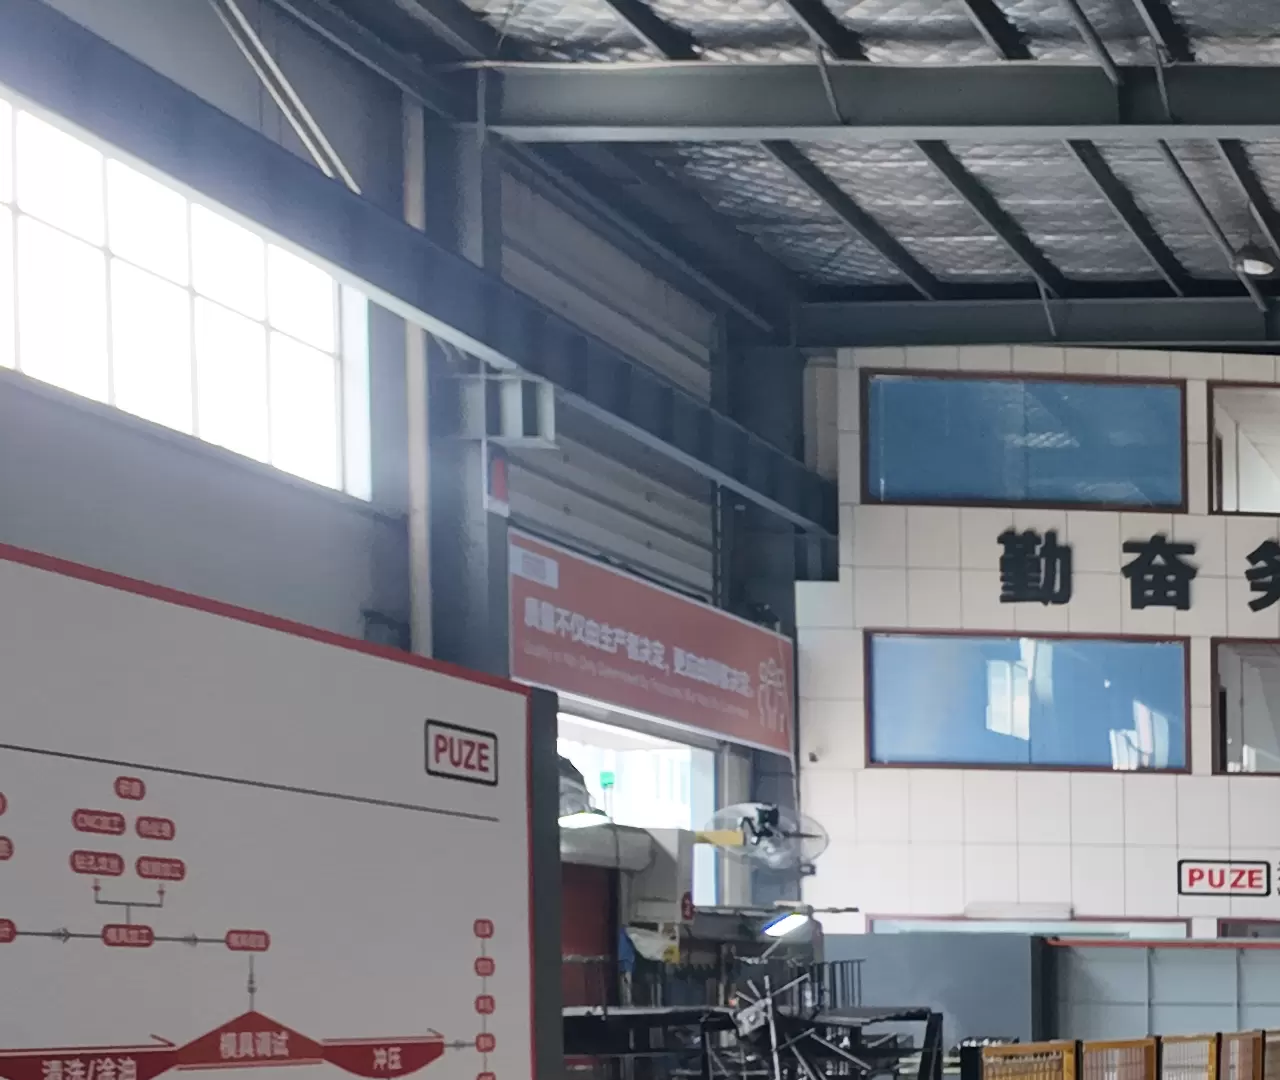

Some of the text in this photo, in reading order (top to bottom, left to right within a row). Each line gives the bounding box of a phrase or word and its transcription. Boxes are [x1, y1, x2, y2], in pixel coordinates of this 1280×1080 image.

[435, 734, 489, 772] PUZE
[1188, 868, 1263, 889] PUZE
[220, 1032, 289, 1058] 模具调试
[373, 1047, 402, 1070] 冲压
